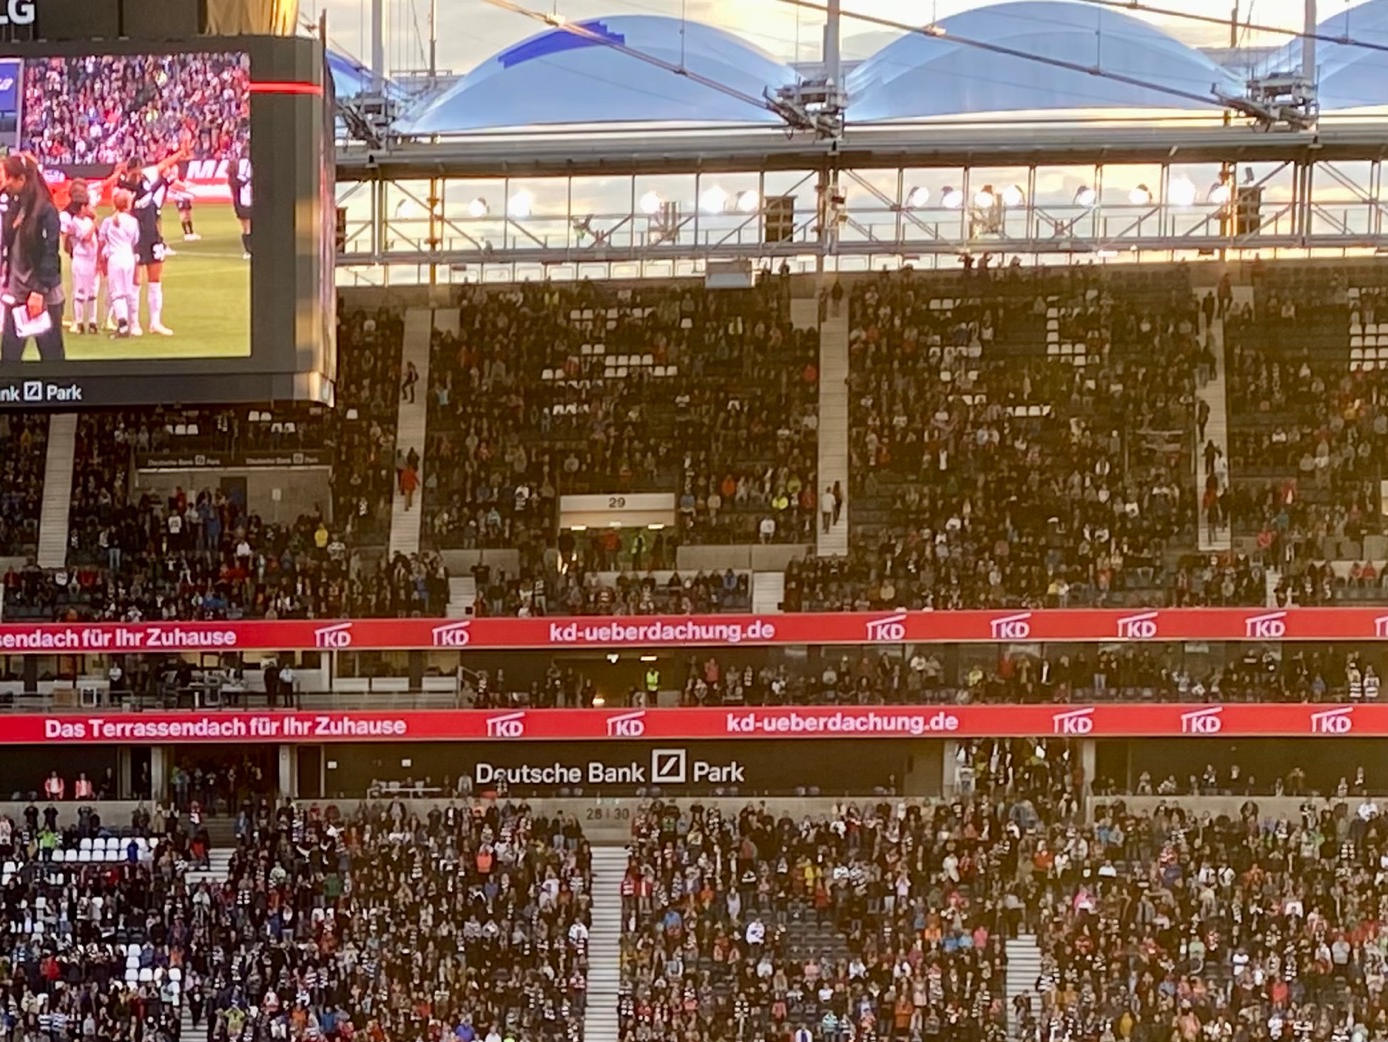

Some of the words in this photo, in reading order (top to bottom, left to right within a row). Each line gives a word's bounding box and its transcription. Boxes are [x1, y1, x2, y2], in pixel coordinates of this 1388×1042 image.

[47, 385, 81, 400] Park
[609, 498, 625, 508] 29
[82, 629, 112, 646] für
[116, 629, 141, 646] Ihr
[146, 626, 236, 647] Zuhause
[550, 620, 774, 642] kd-ueberdachung.de
[46, 720, 85, 737] Das
[89, 718, 246, 737] Terrassendach
[250, 718, 279, 735] für
[284, 717, 312, 735] Ihr
[315, 717, 406, 734] Zuhause
[728, 712, 958, 737] kd-ueberdachung.de
[477, 763, 581, 785] Deutsche
[589, 763, 644, 782] Bank
[694, 762, 744, 781] Park
[586, 808, 602, 820] 28
[614, 808, 630, 820] 30
